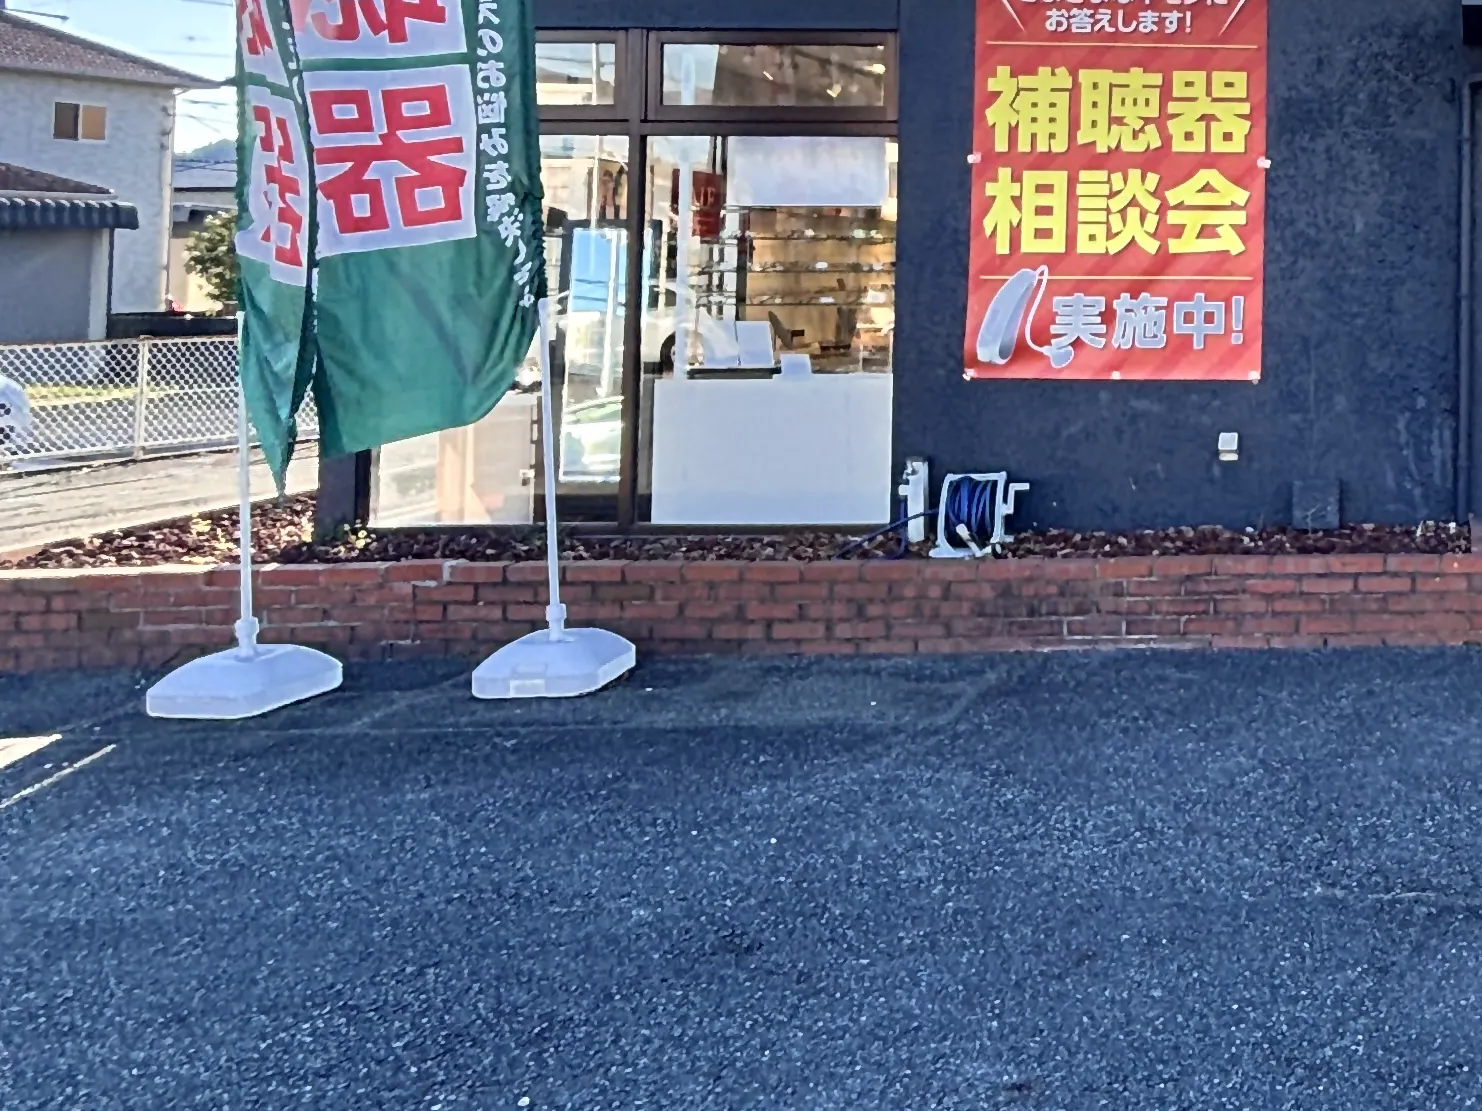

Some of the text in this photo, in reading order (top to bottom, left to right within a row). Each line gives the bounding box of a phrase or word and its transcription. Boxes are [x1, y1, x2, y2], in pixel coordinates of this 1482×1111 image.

[984, 65, 1253, 154] 補聴器
[982, 167, 1251, 256] 相談会
